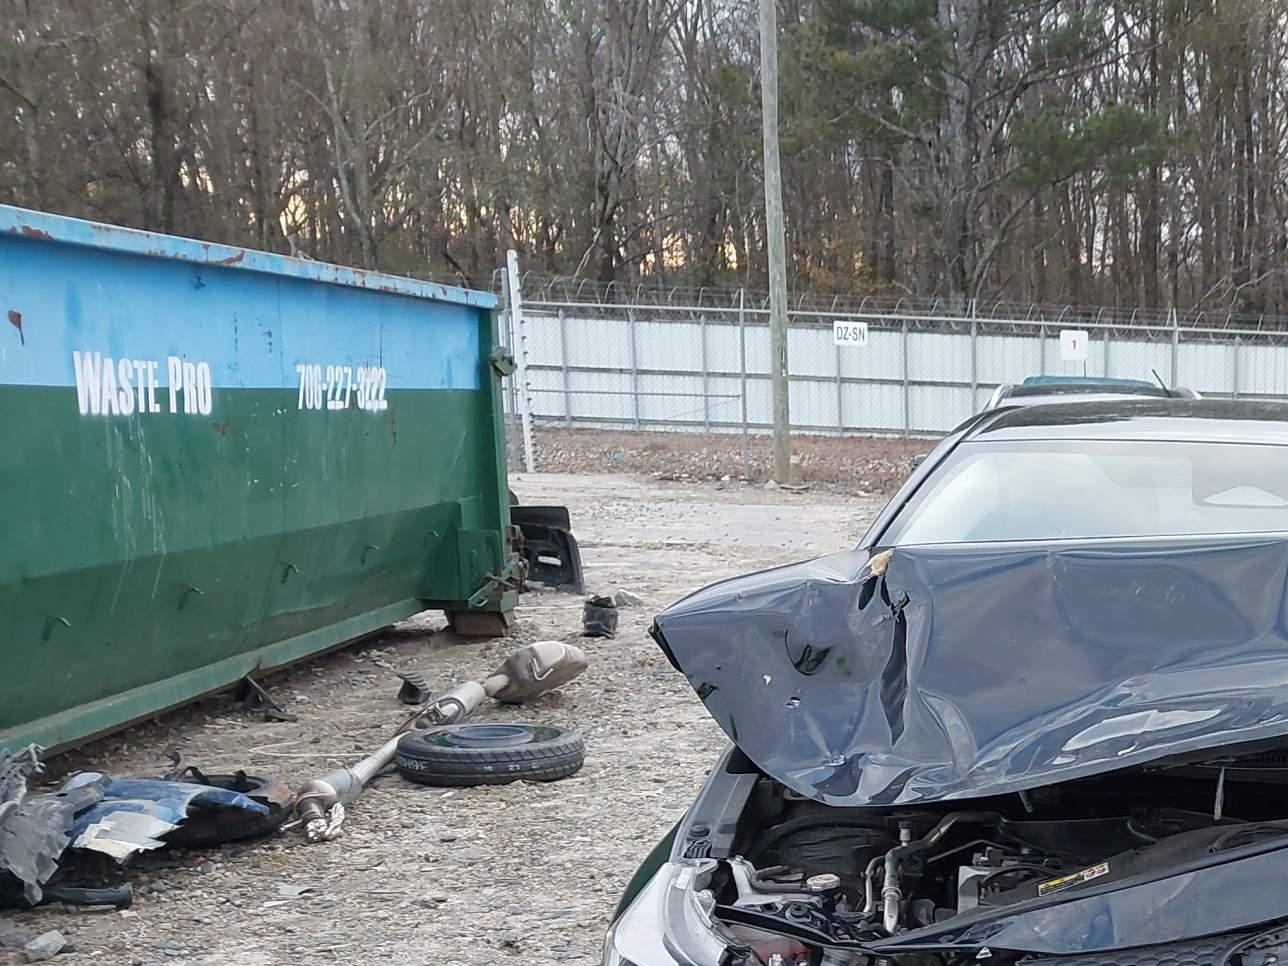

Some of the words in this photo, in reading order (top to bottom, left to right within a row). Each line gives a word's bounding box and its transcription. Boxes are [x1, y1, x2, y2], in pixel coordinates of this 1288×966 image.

[836, 326, 865, 342] DZ-SN
[1071, 339, 1077, 350] 1
[73, 351, 160, 416] WASTE
[168, 356, 212, 416] PRO
